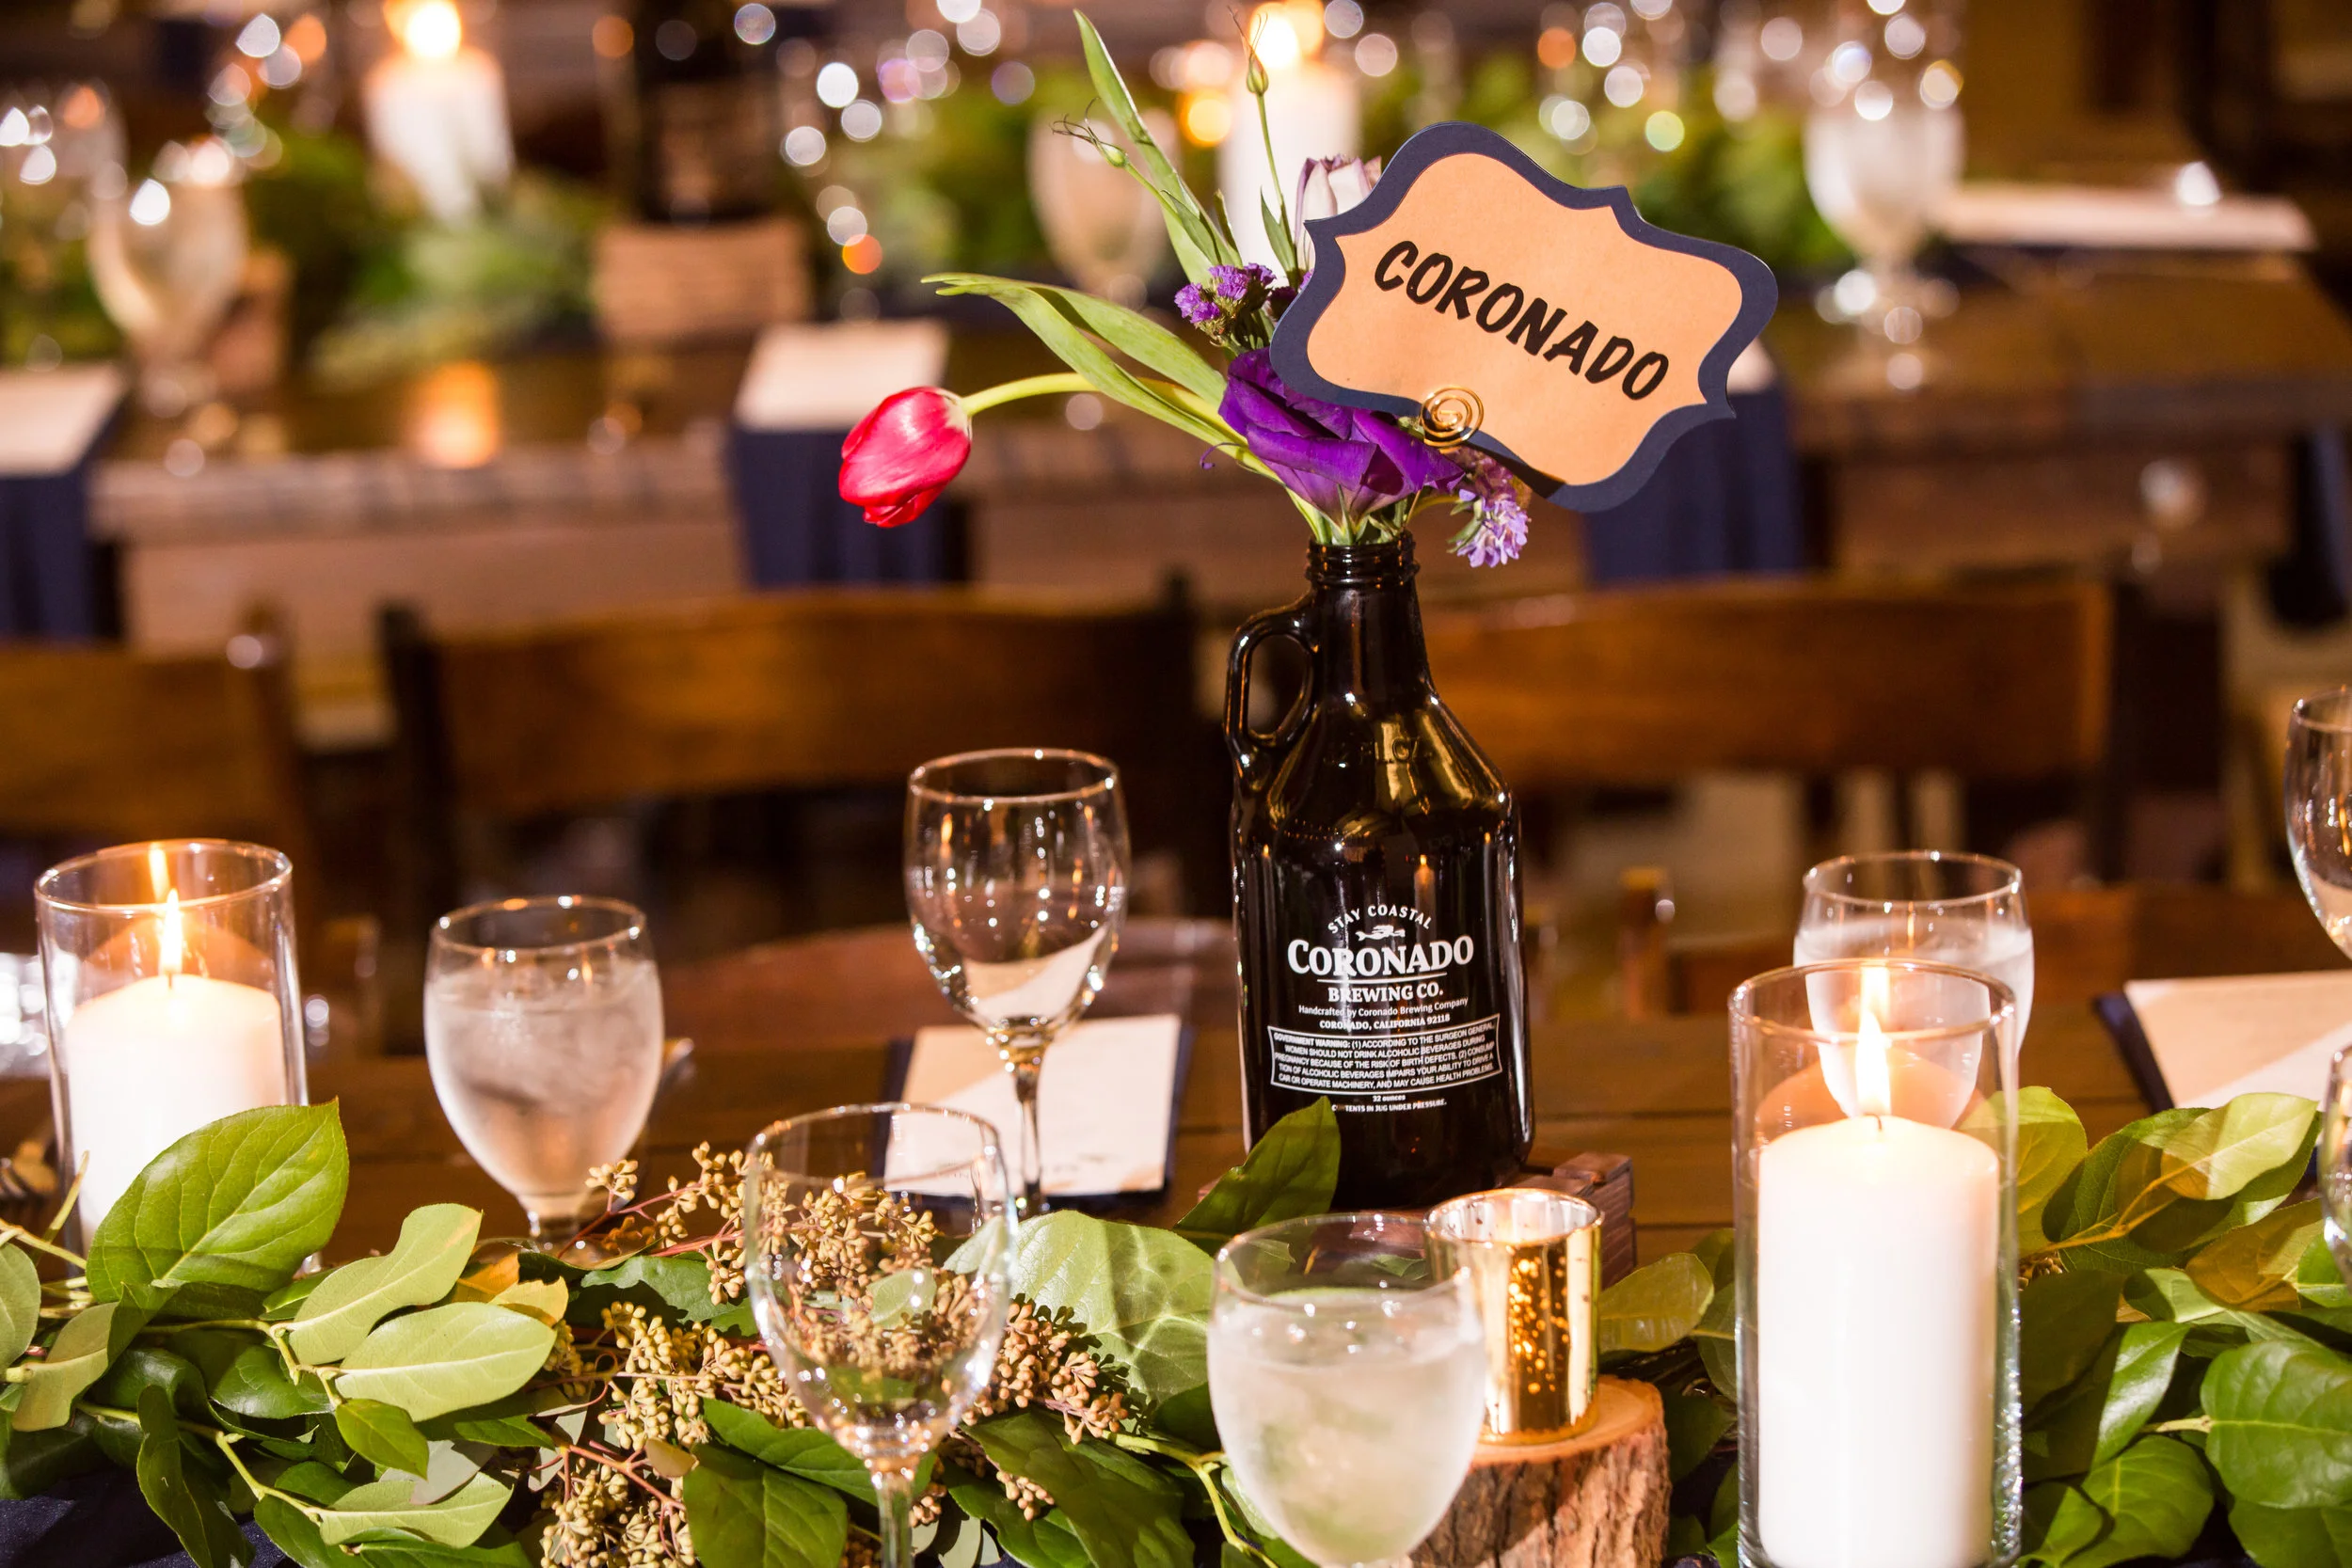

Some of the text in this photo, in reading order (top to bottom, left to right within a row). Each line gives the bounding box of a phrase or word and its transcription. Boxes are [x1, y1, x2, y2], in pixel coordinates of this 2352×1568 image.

[1374, 240, 1670, 401] CORONADO
[1327, 904, 1433, 934] STAY COASTAL
[1287, 935, 1474, 976] CORONADO
[1327, 981, 1444, 1003] BREWING CO.
[1298, 997, 1469, 1018] Handcrafted by Coronado Brewing Company
[1319, 1013, 1451, 1031] CORONADO, CALIFORNIA 92118
[1274, 1032, 1314, 1046] GOVERNMENT
[1315, 1038, 1350, 1049] WARNING:
[1352, 1040, 1361, 1050] (1)
[1362, 1038, 1406, 1048] ACCORDING
[1407, 1037, 1419, 1045] TO
[1419, 1035, 1434, 1044] THE
[1435, 1029, 1468, 1042] SURGEON
[1284, 1034, 1486, 1059] WOMEN SHOULD NOT DRINK ALCOHOLIC BEVERAGES DURING
[1293, 1066, 1302, 1074] OF
[1301, 1067, 1340, 1078] ALCOHOLIC
[1340, 1070, 1384, 1079] BEVERAGES
[1386, 1068, 1416, 1078] IMPAIRS
[1416, 1065, 1437, 1075] YOUR
[1438, 1062, 1462, 1072] ABILITY
[1463, 1059, 1471, 1069] TO
[1472, 1053, 1489, 1066] DRIVE
[1310, 1058, 1343, 1069] BECAUSE
[1343, 1060, 1354, 1069] OF
[1355, 1060, 1370, 1069] THE
[1371, 1059, 1389, 1069] RISK
[1390, 1058, 1401, 1068] OF
[1402, 1055, 1423, 1067] BIRTH
[1458, 1049, 1467, 1060] (2)
[1279, 1072, 1291, 1083] CAR
[1291, 1075, 1301, 1085] OR
[1301, 1077, 1331, 1087] OPERATE
[1331, 1080, 1375, 1090] MACHINERY,
[1375, 1080, 1392, 1088] AND
[1393, 1079, 1410, 1088] MAY
[1410, 1075, 1436, 1086] CAUSE
[1436, 1070, 1462, 1084] HEALTH
[1375, 1103, 1389, 1112] JUG
[1389, 1102, 1412, 1111] UNDER
